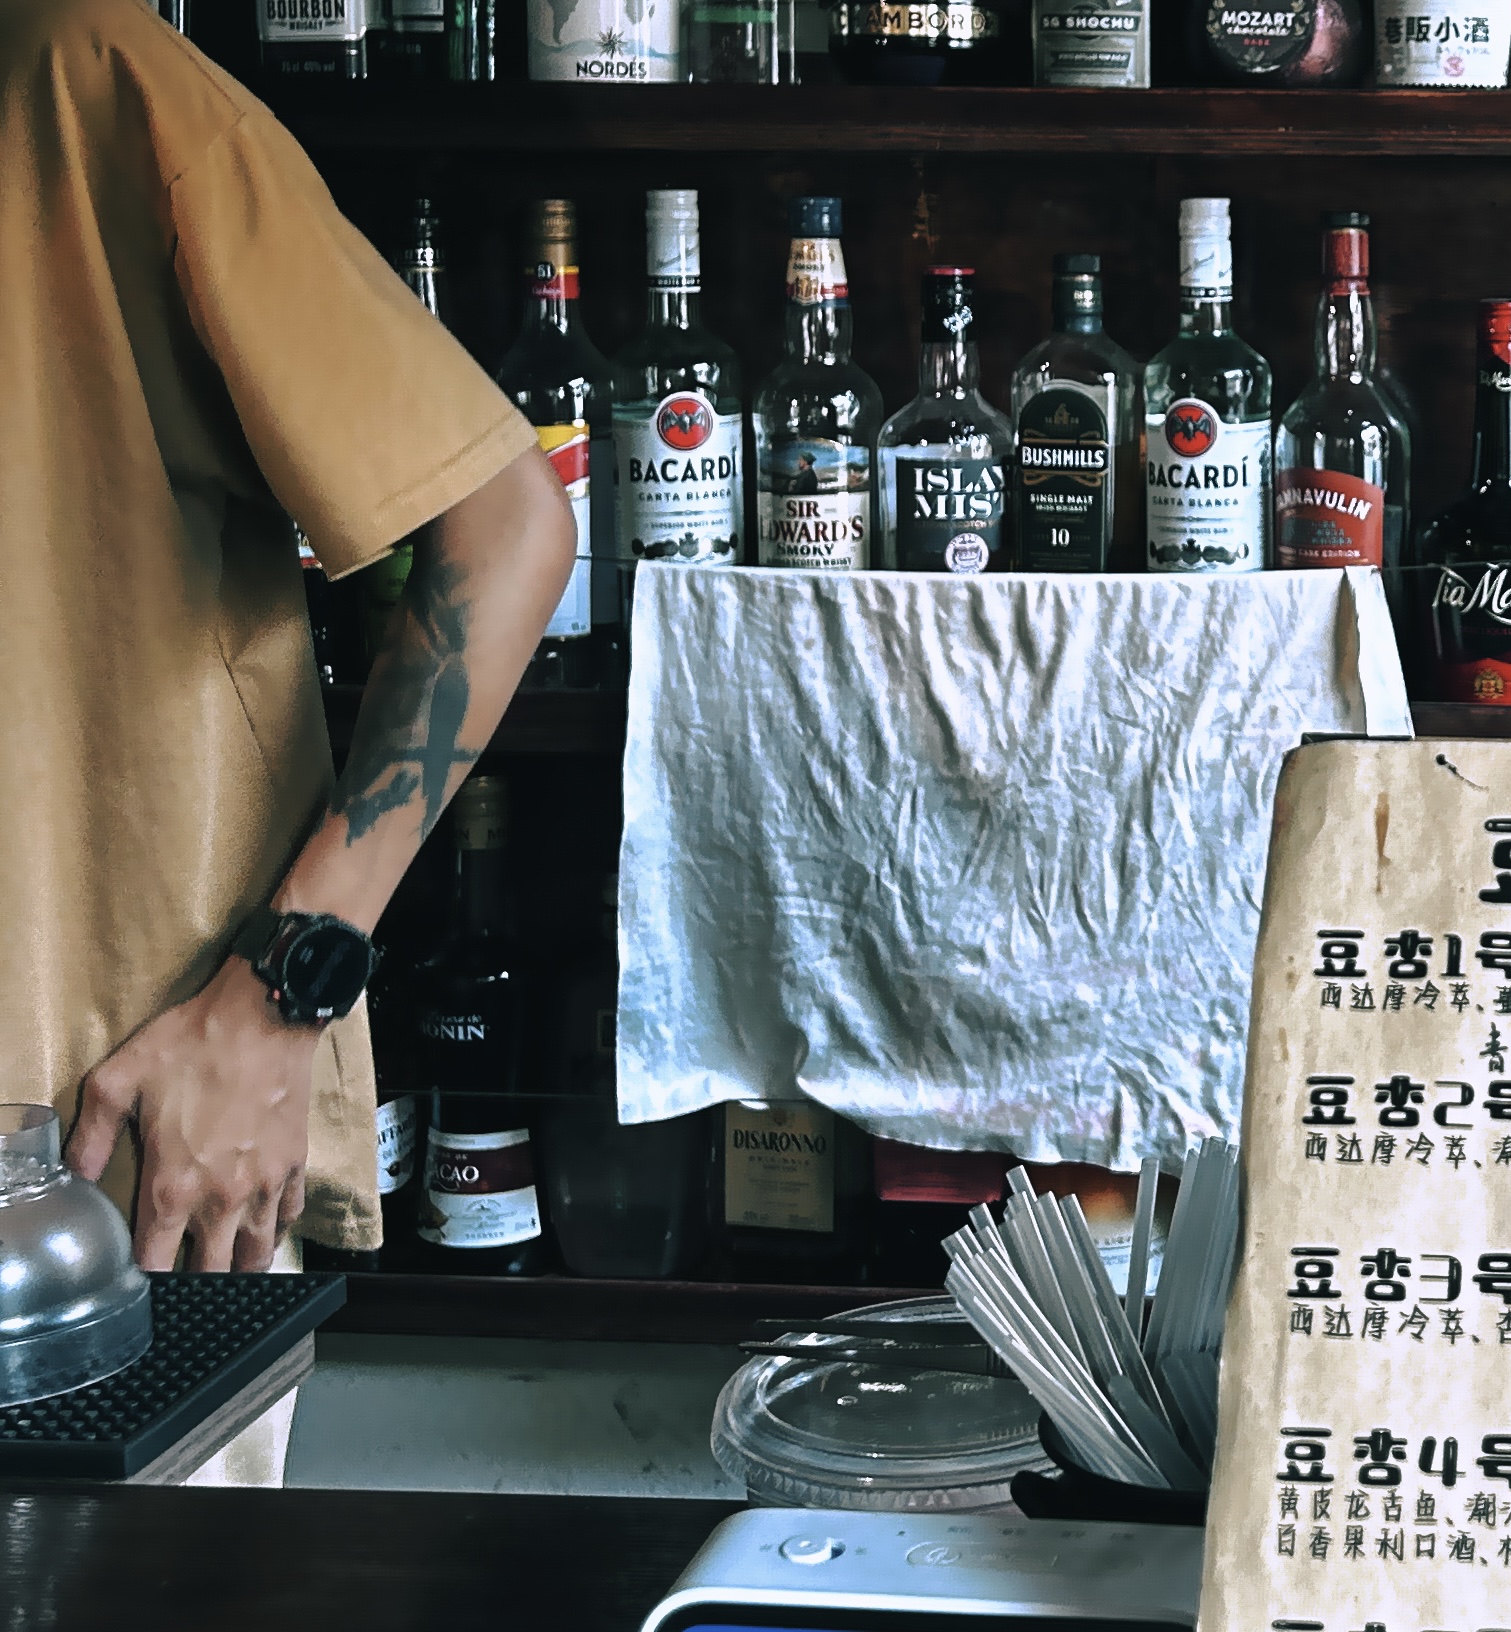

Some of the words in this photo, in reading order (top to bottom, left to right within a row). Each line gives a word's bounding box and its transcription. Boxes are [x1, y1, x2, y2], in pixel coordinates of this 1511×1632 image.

[1066, 16, 1135, 30] SHOCHU
[1221, 11, 1296, 27] MOZART
[1022, 446, 1105, 468] BUSHMILLS
[1030, 493, 1064, 504] SINGLE
[786, 499, 821, 517] SIR
[1051, 528, 1070, 547] 10
[733, 1128, 827, 1154] DISARONNO
